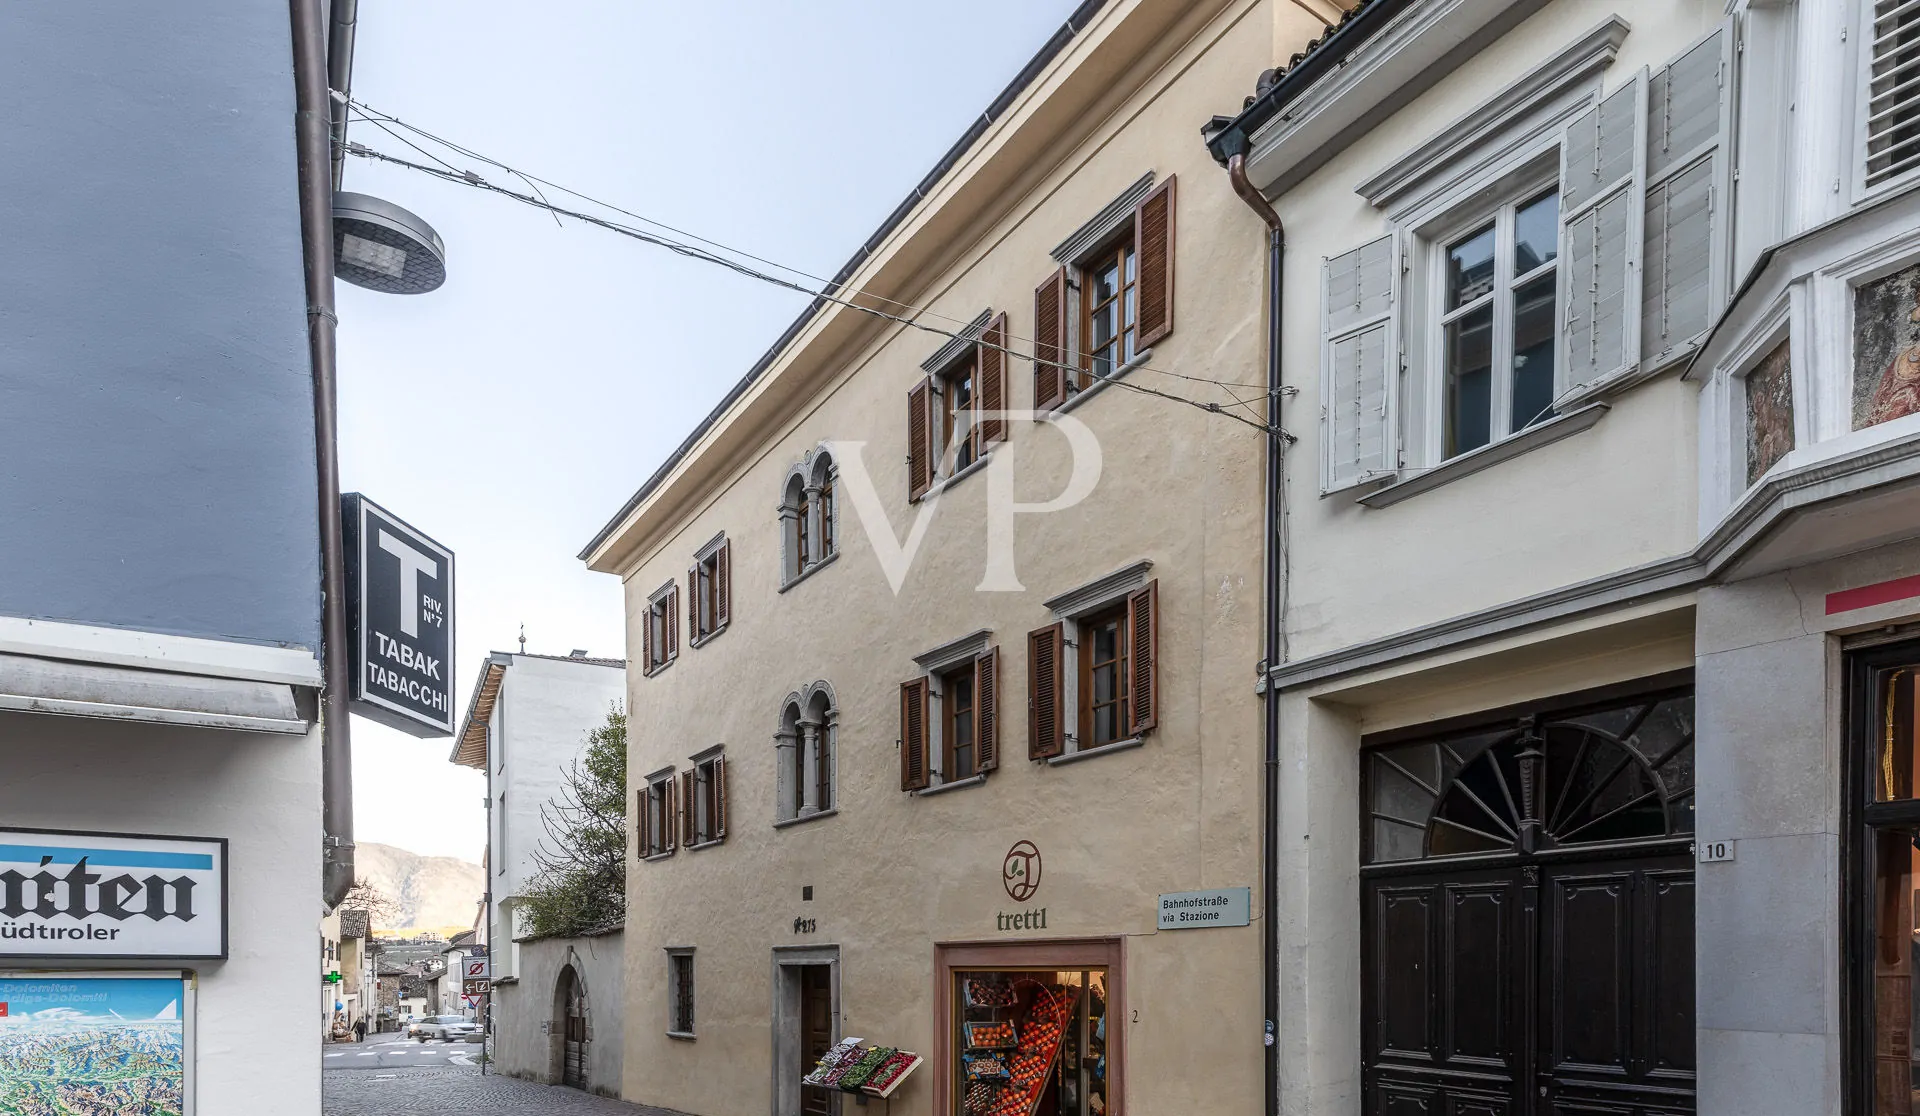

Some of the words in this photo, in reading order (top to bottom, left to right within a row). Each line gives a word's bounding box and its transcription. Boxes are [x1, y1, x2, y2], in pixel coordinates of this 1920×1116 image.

[379, 528, 437, 639] T
[423, 594, 443, 615] RIV.
[375, 631, 440, 681] TABAK
[368, 661, 447, 713] TABACCHI
[1707, 843, 1725, 859] 10
[1163, 896, 1229, 909] Bahnhofstraße
[997, 908, 1047, 931] trettl
[1163, 913, 1175, 922] via
[1179, 911, 1219, 922] Stazione
[1132, 1009, 1139, 1023] 2
